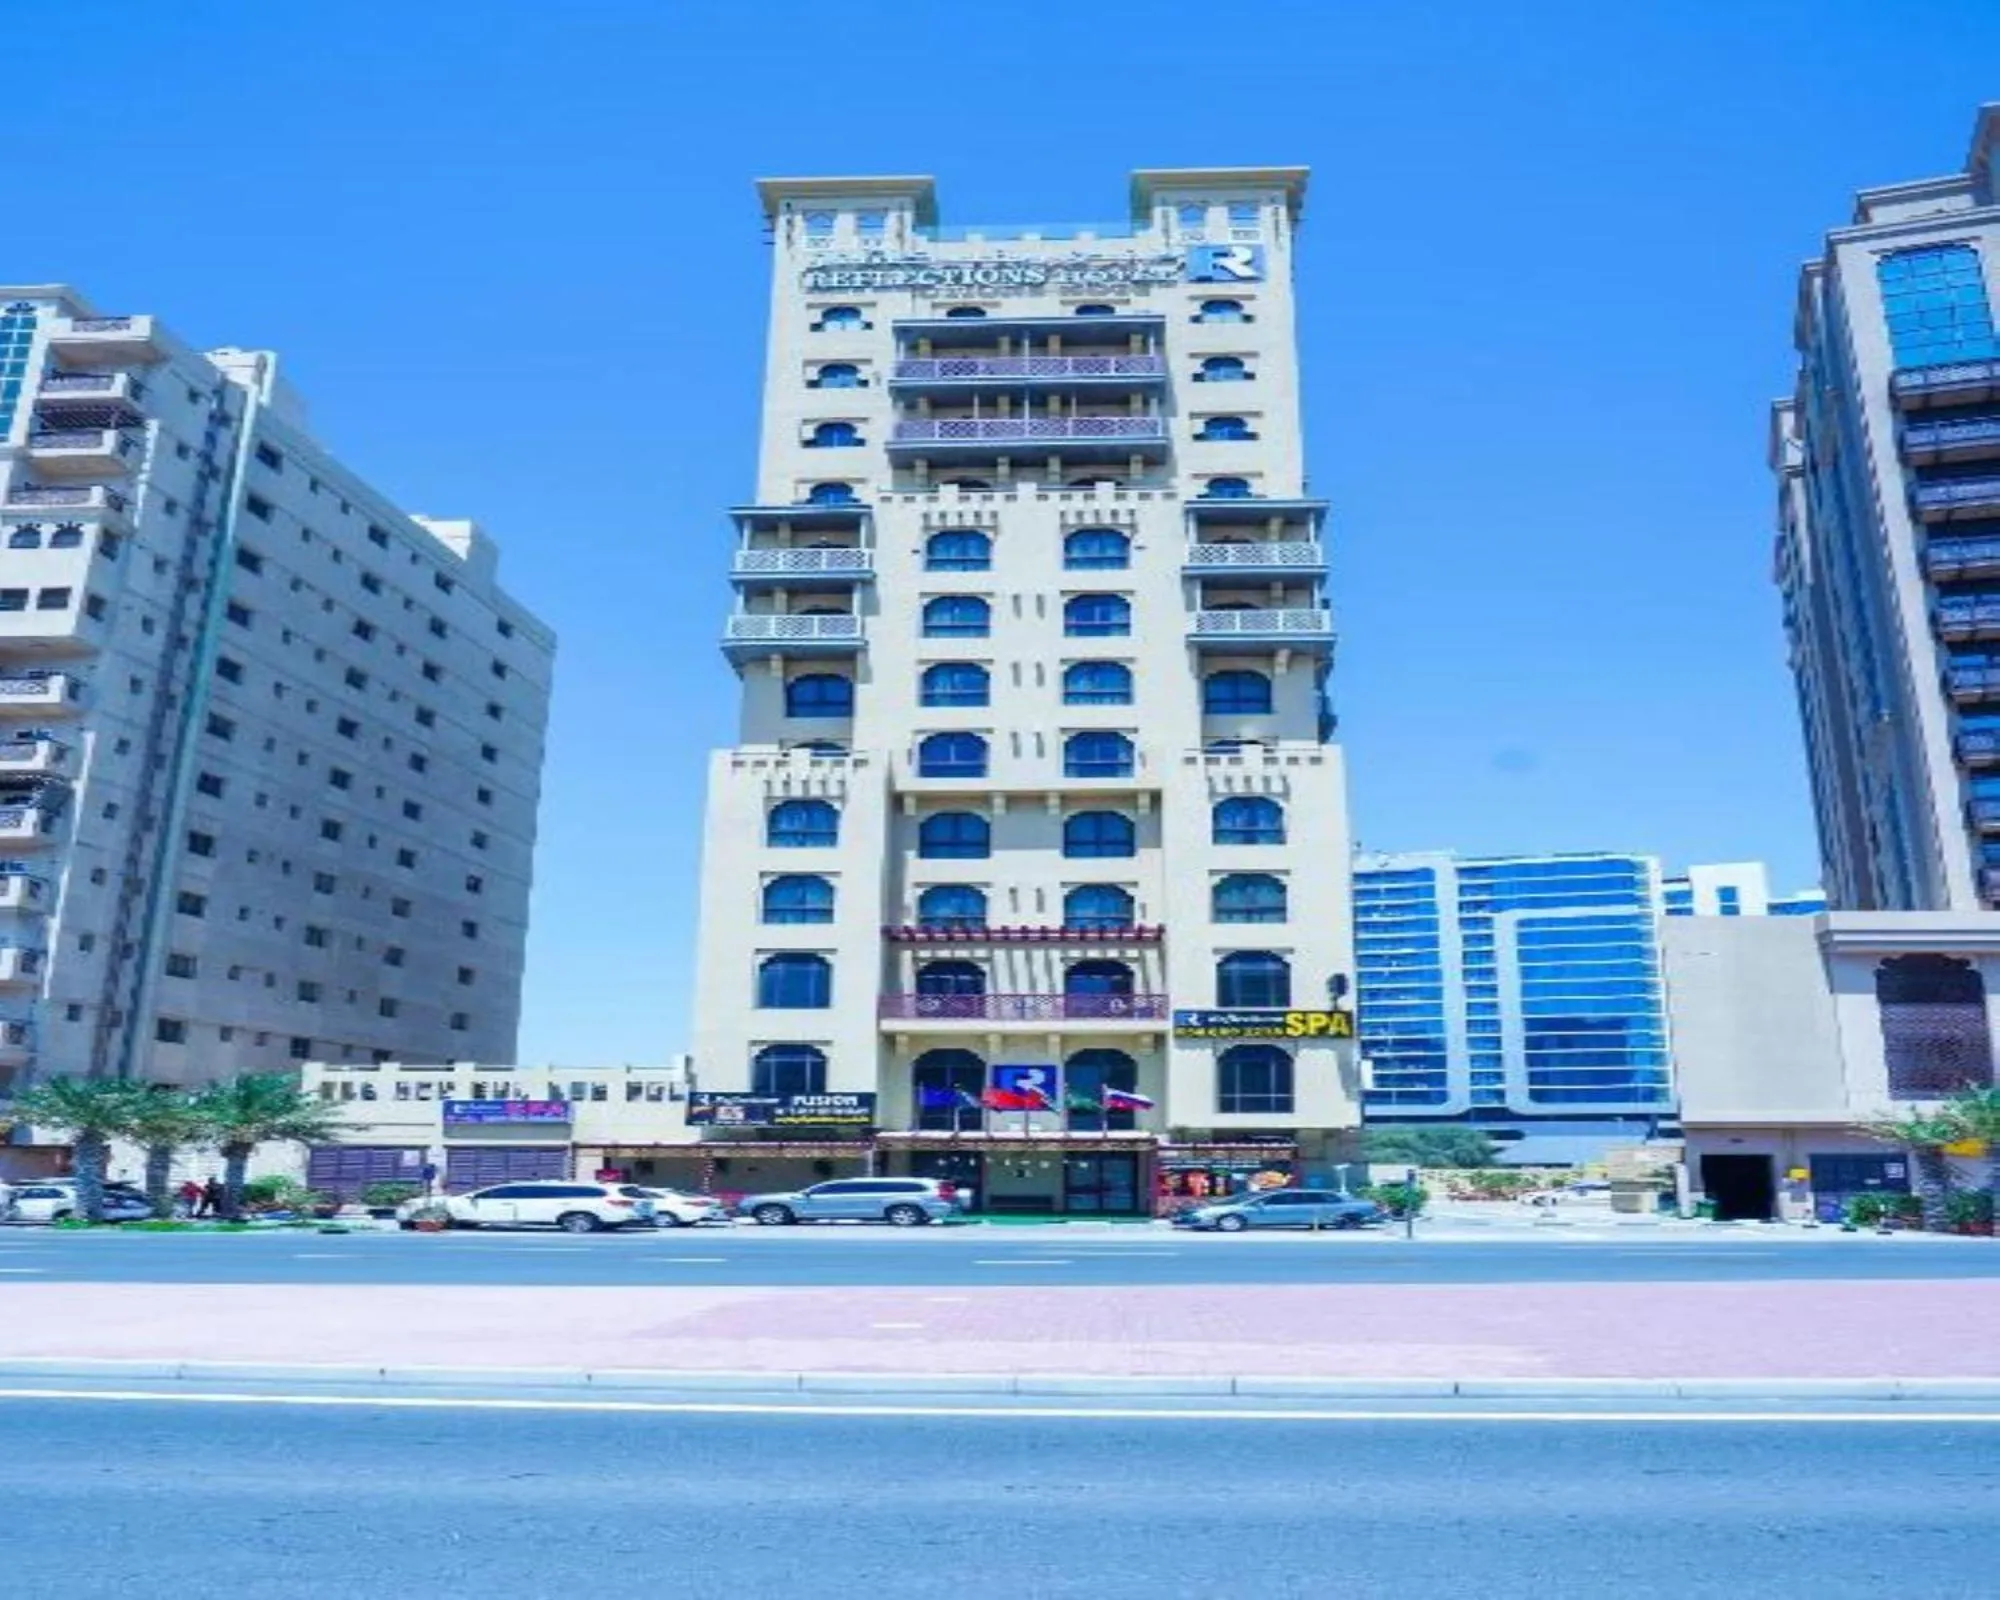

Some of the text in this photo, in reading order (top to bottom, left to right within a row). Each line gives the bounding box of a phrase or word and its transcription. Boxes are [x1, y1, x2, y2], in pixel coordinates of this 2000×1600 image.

[805, 267, 1178, 287] REFLECTIONS HOTEL
[1285, 1012, 1350, 1037] SPA
[792, 1095, 859, 1107] FUSION
